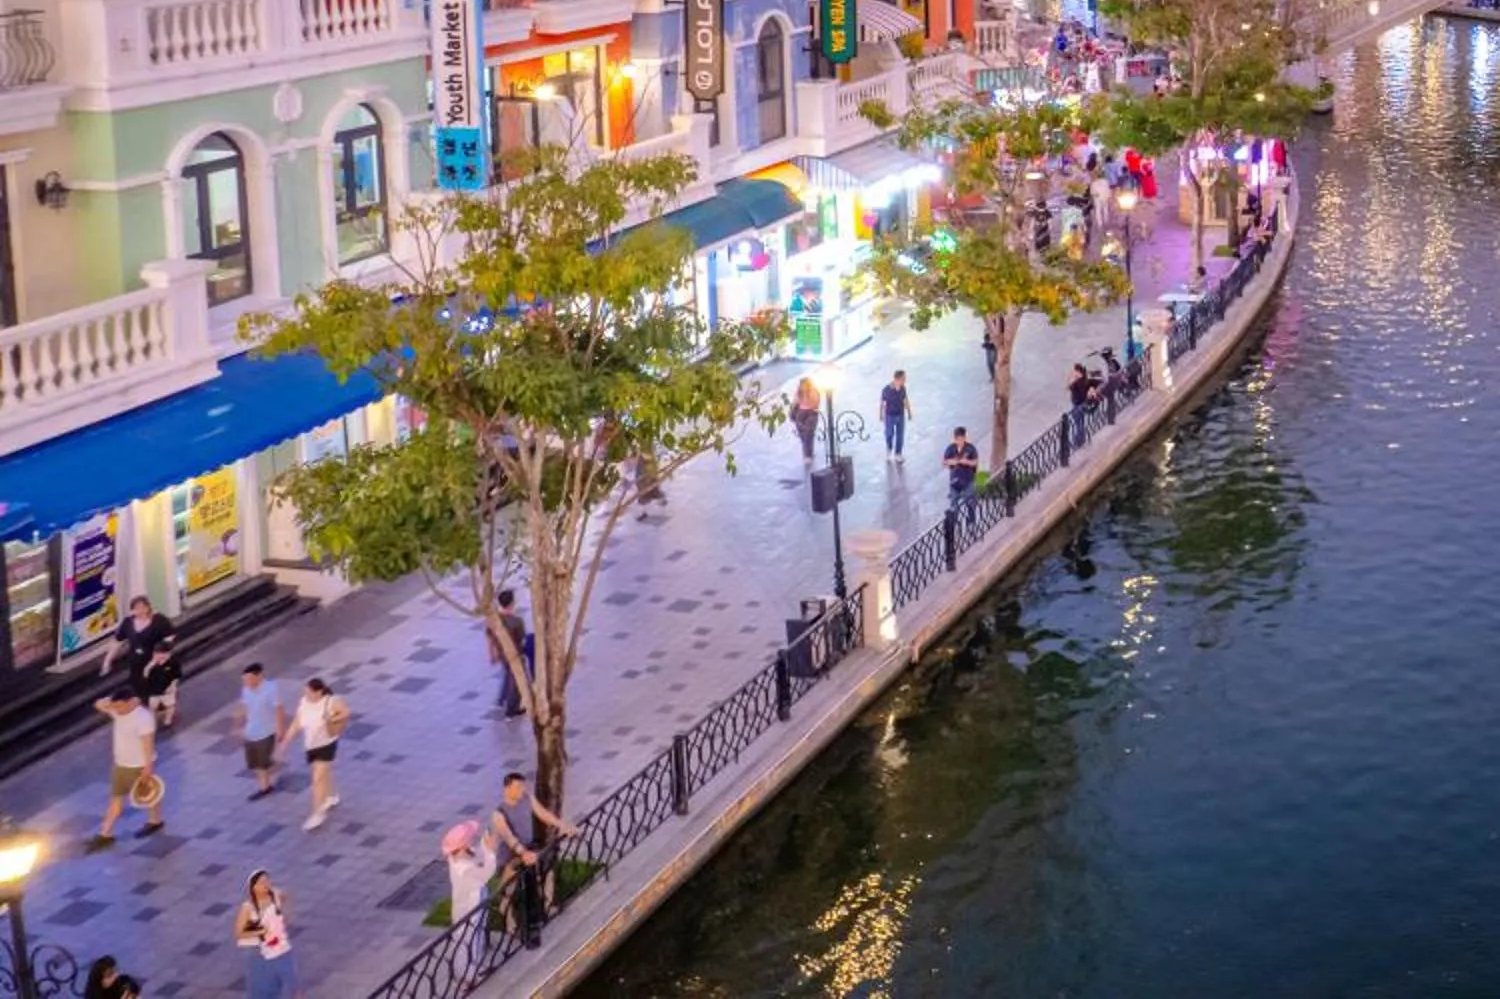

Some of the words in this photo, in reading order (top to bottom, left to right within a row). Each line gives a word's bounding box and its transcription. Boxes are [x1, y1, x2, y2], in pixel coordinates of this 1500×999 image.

[441, 1, 463, 67] Market
[831, 29, 847, 53] SPA
[444, 73, 464, 125] Youth
